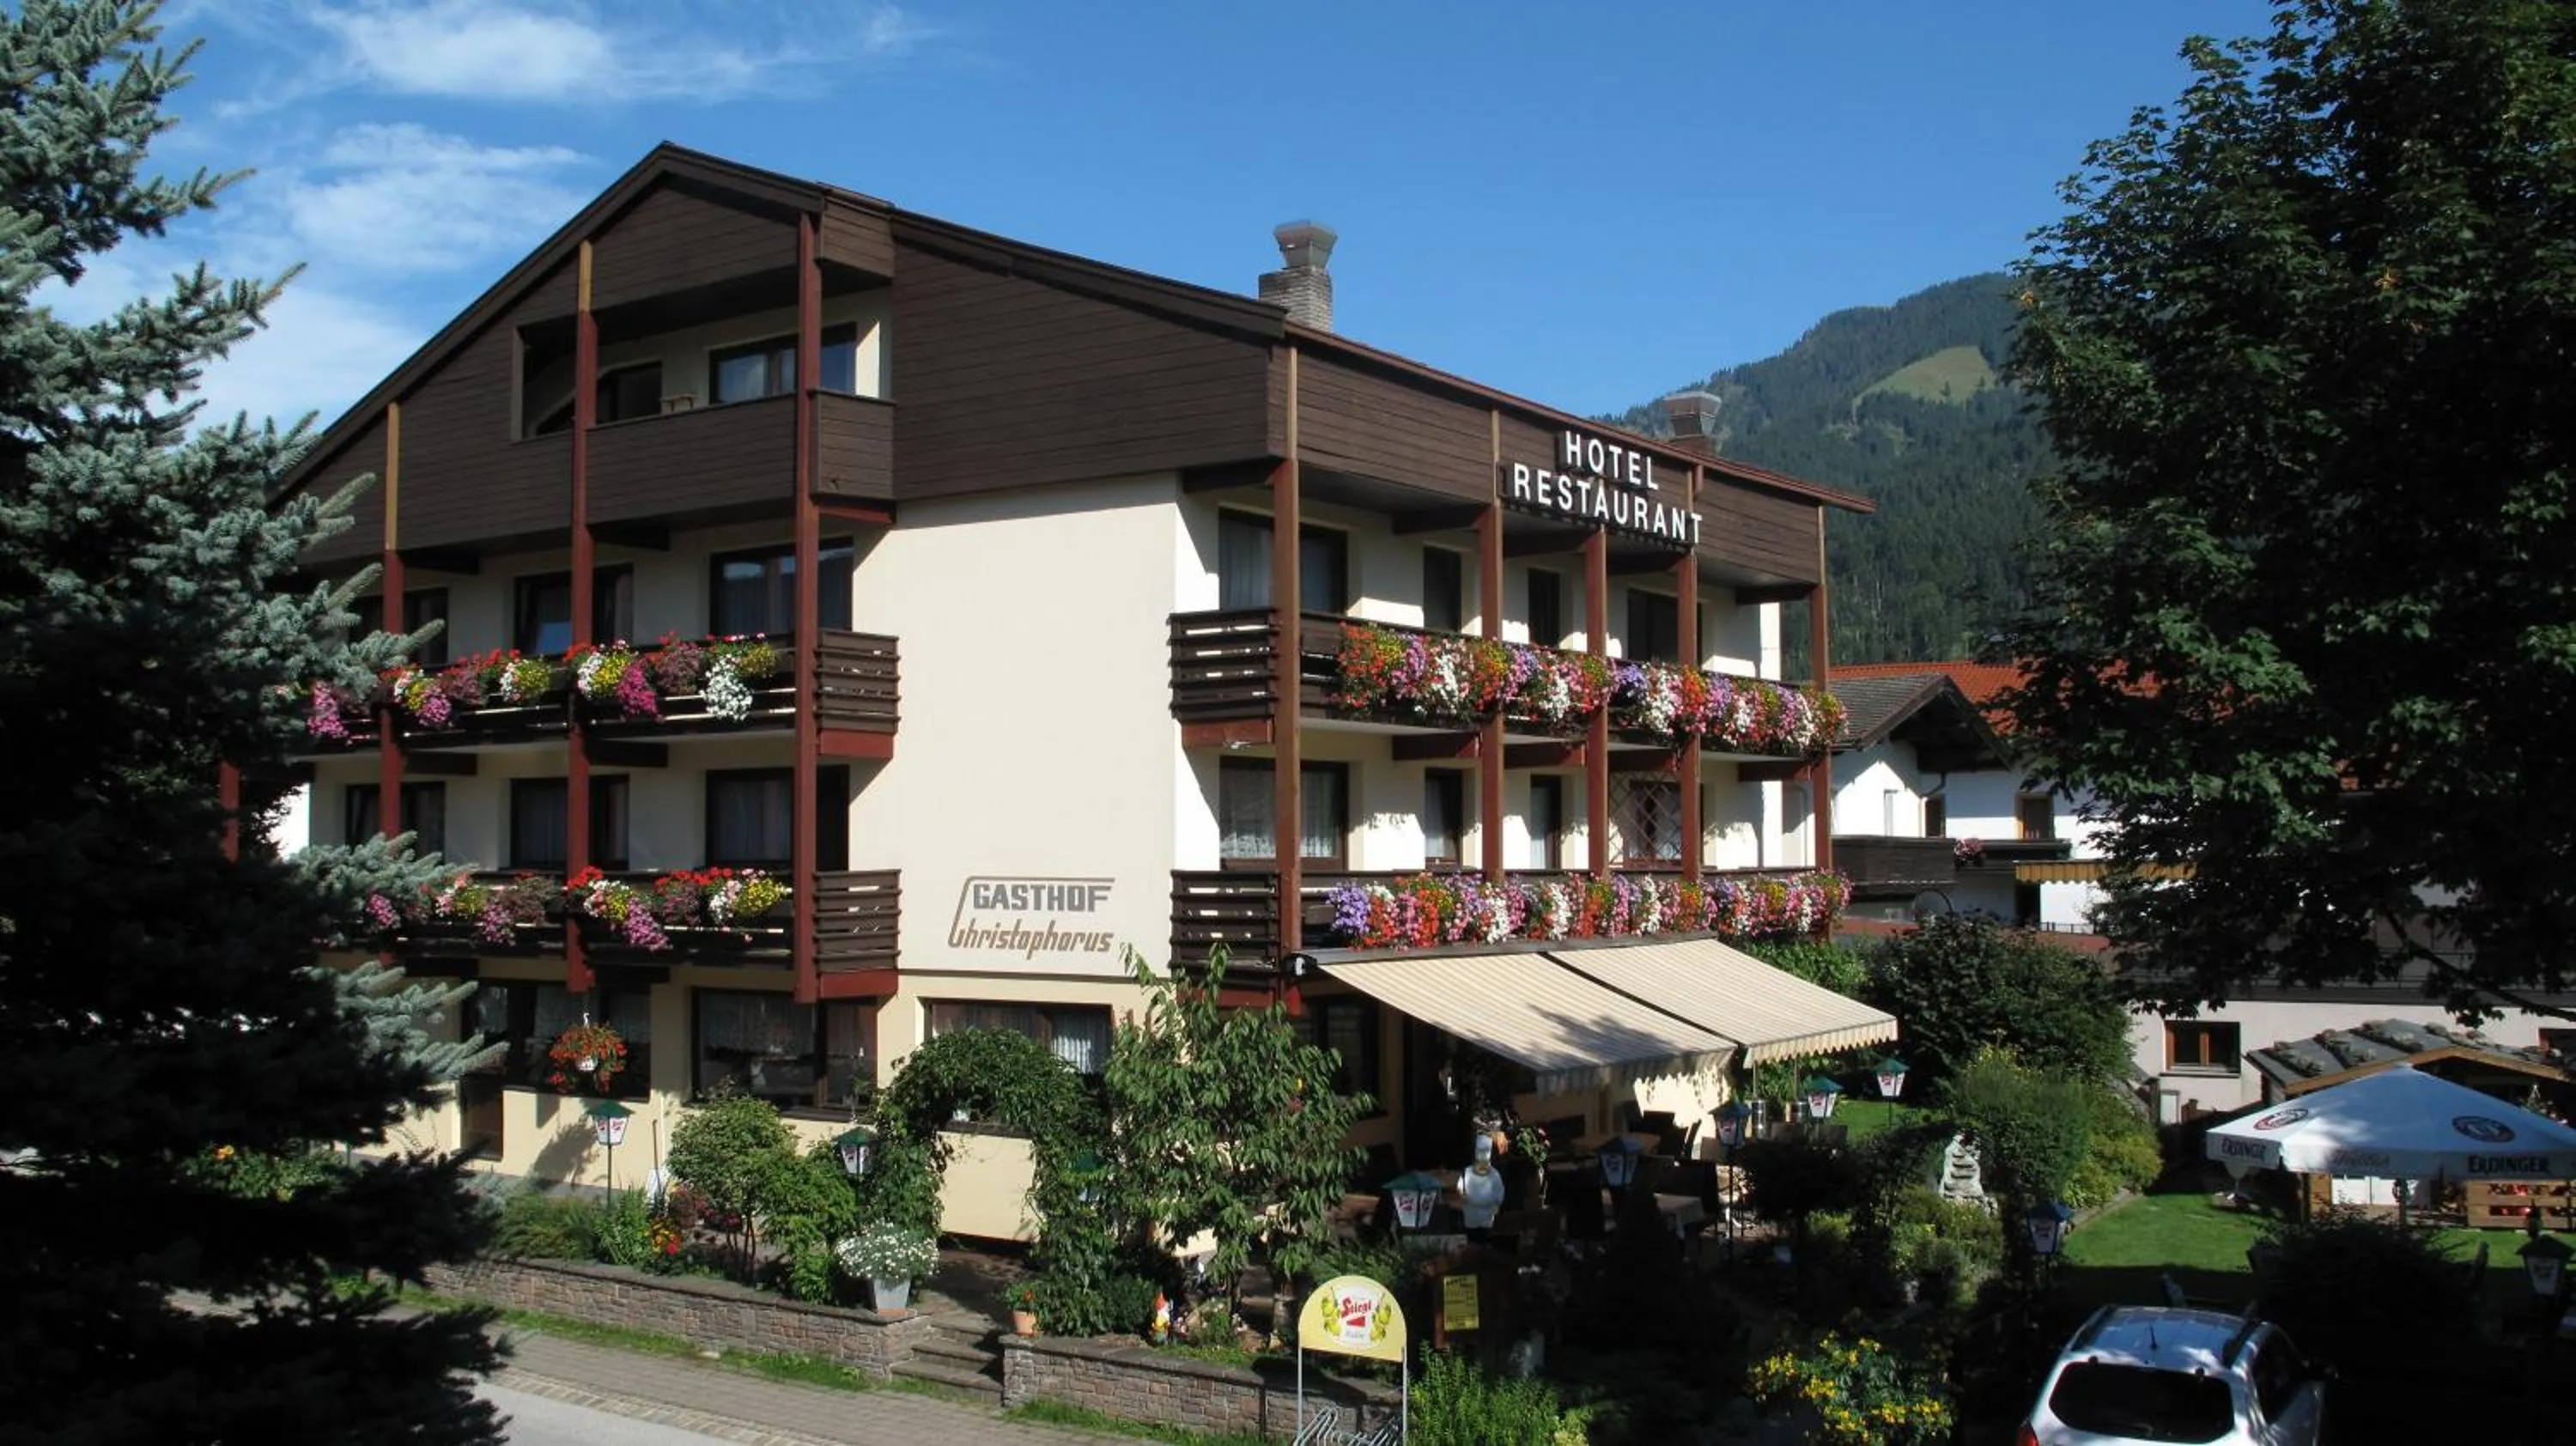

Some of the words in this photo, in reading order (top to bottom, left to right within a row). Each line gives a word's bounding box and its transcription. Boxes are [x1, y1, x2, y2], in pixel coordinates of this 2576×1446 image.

[1565, 431, 1658, 489] HOTEL
[1514, 463, 1703, 544] RESTAURANT
[973, 884, 1112, 912] GASTHOF
[947, 917, 1115, 960] Christophorus
[2469, 1154, 2553, 1175] ERDINGER
